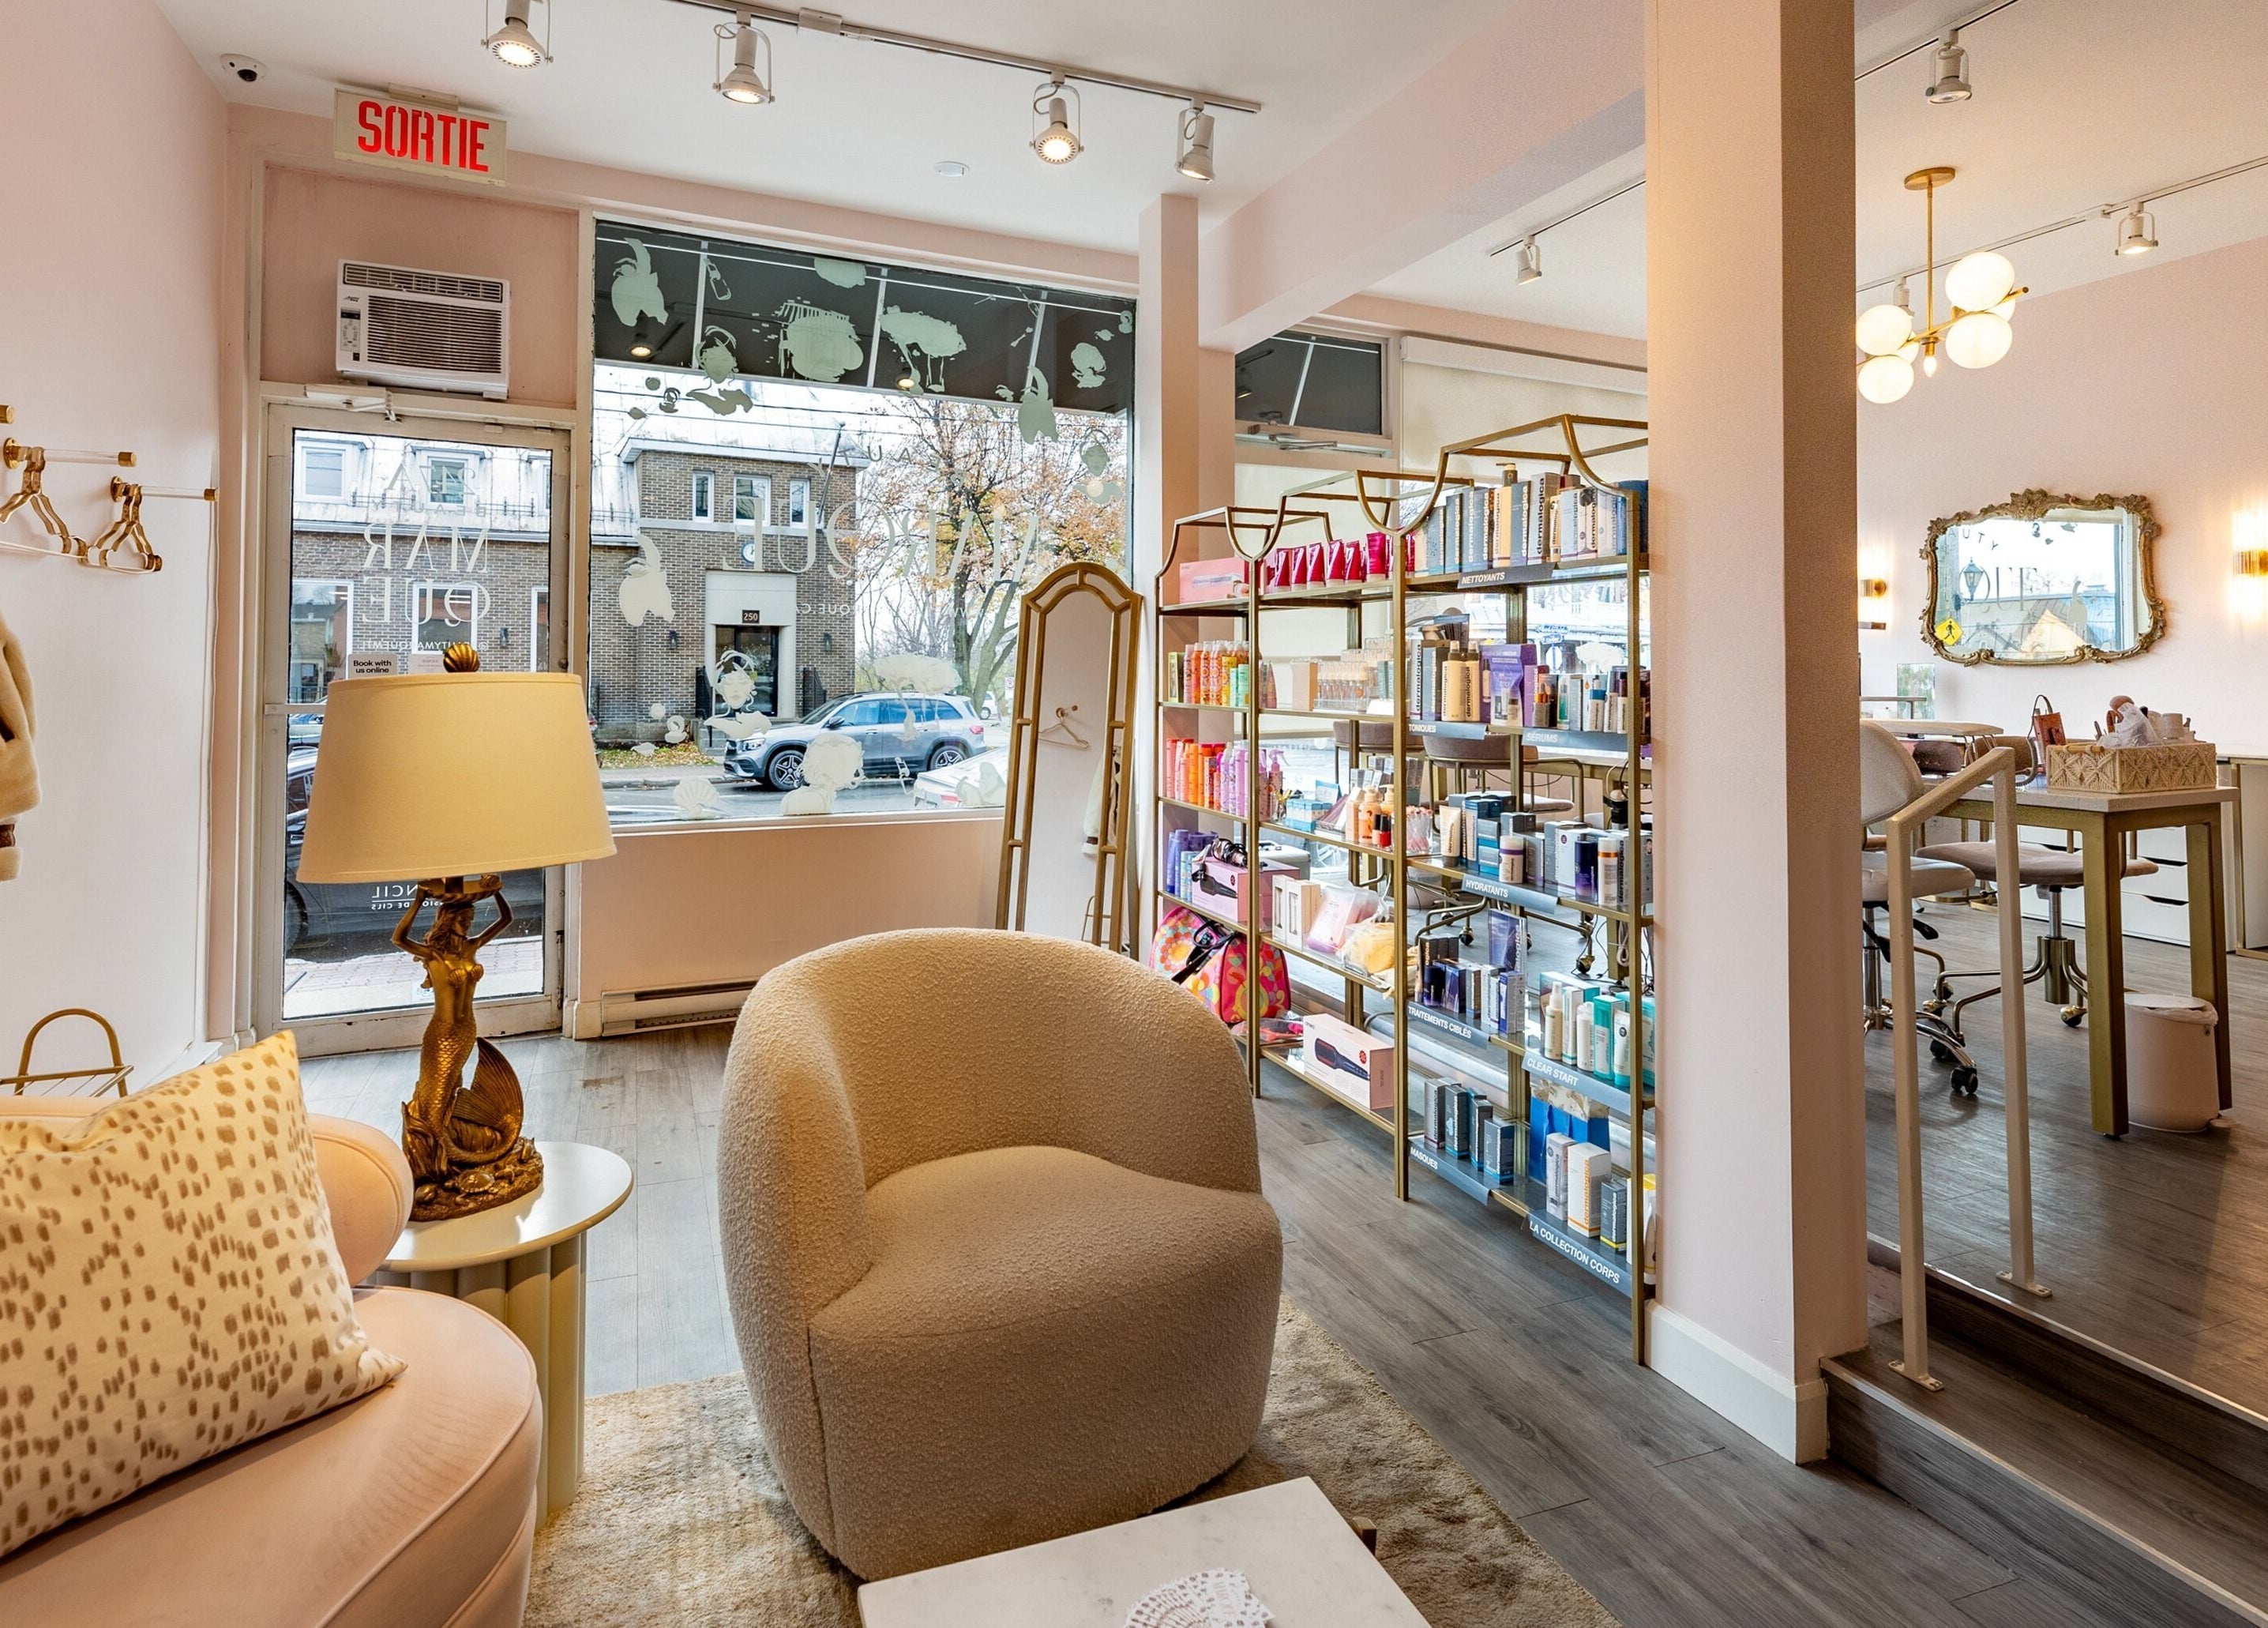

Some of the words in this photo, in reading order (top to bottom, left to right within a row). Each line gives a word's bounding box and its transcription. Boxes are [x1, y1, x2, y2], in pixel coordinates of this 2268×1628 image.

[357, 100, 490, 173] SORTIE
[1461, 571, 1506, 585] NETTOYANTS
[742, 611, 759, 622] 250
[1408, 724, 1437, 733] TONIQUES
[1465, 878, 1509, 898] HYDRATANTS
[1408, 1006, 1448, 1029] TRAITEMENTS
[1448, 1022, 1472, 1040] CIBLÉS
[1526, 1057, 1553, 1076] CLEAR
[1553, 1066, 1579, 1087] START
[1410, 1146, 1438, 1170] MASQUES
[1529, 1221, 1539, 1234] LA
[1540, 1228, 1589, 1265] COLLECTION
[1589, 1258, 1620, 1284] CORPS
